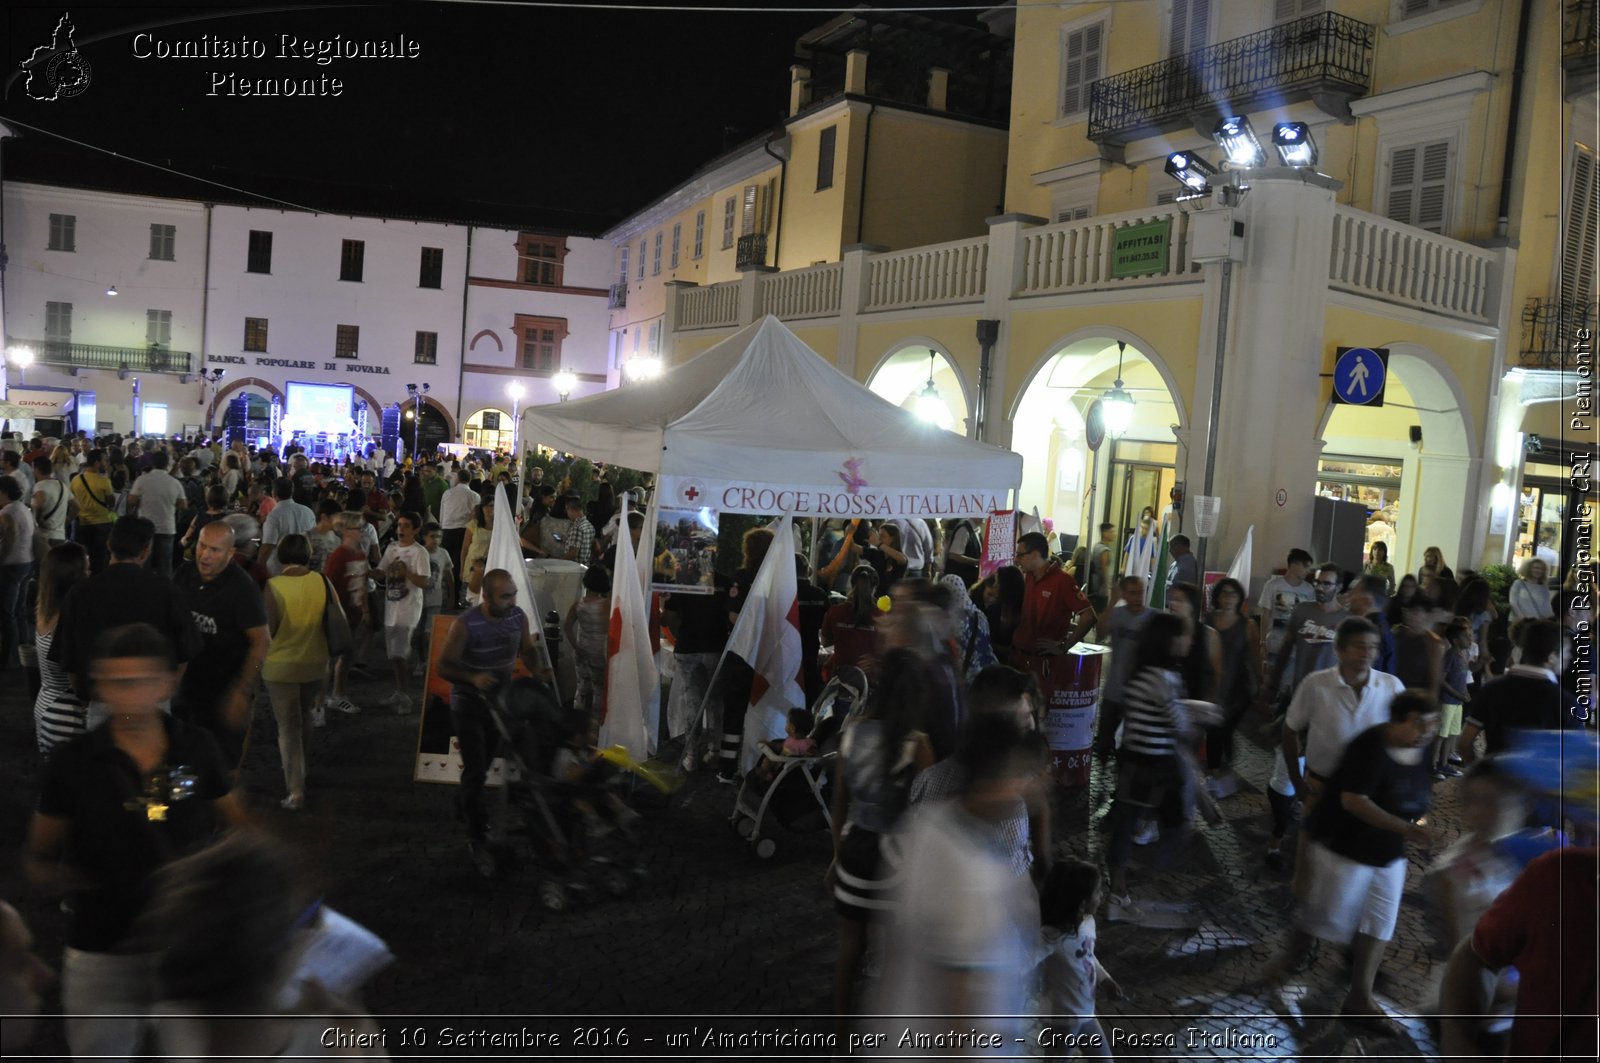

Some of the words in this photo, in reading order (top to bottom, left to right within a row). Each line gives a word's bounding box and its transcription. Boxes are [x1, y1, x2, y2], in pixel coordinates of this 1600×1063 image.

[1117, 234, 1164, 250] AFFITTASI
[207, 354, 247, 365] BANCA
[255, 357, 316, 370] POPOLARE
[324, 362, 337, 371] DI
[345, 364, 391, 375] NOVARA
[18, 399, 59, 408] GIMAX
[722, 486, 810, 513] CROCE
[816, 493, 893, 515] ROSSA
[898, 494, 998, 515] ITALIANA
